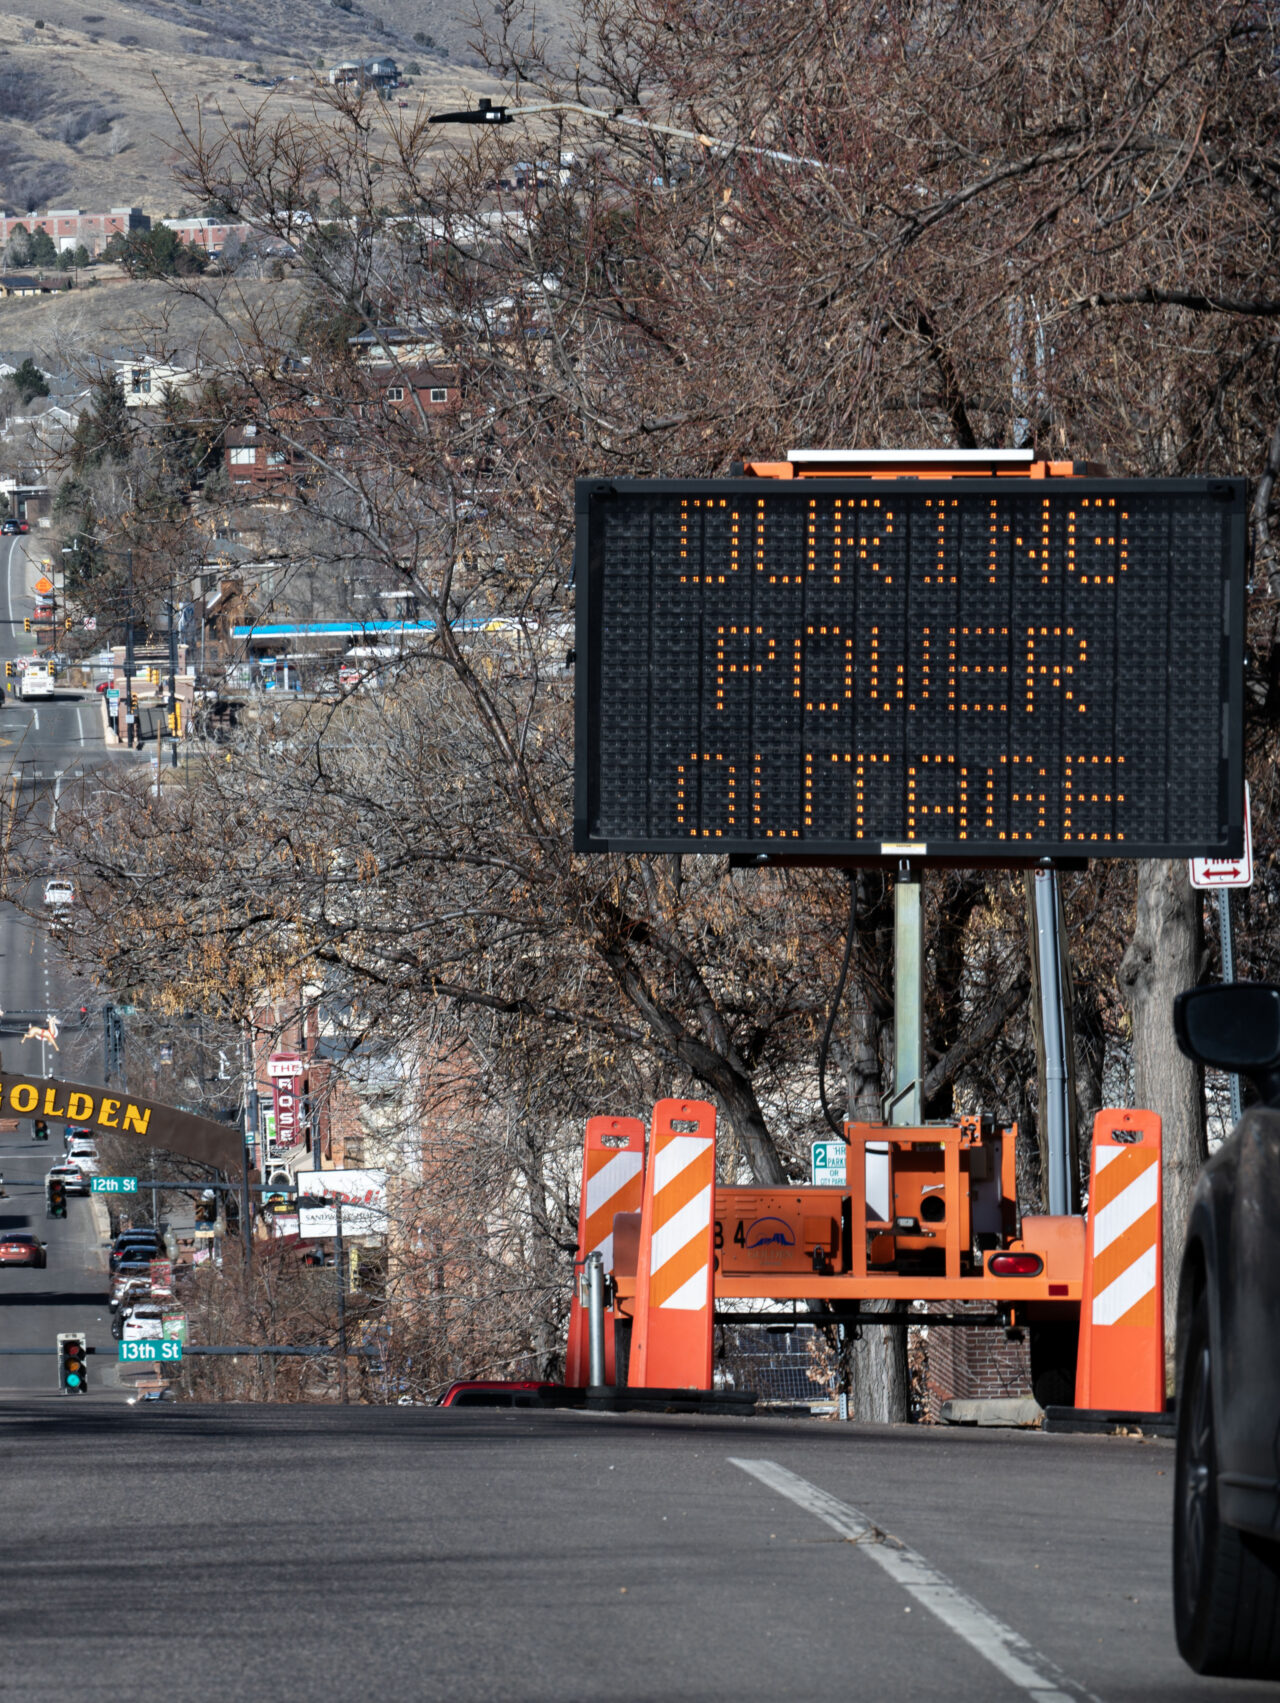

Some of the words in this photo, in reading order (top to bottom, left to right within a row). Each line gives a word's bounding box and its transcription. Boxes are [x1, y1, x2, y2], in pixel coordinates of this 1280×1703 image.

[680, 499, 1129, 584] DURING
[717, 626, 1087, 712] POWER
[677, 753, 1125, 840] OUTAGE
[271, 1064, 301, 1073] THE
[278, 1078, 294, 1142] ROSE
[815, 1147, 825, 1166] 2
[92, 1178, 118, 1191] 12th
[123, 1178, 136, 1191] St
[121, 1343, 156, 1359] 13th
[162, 1342, 180, 1359] St
